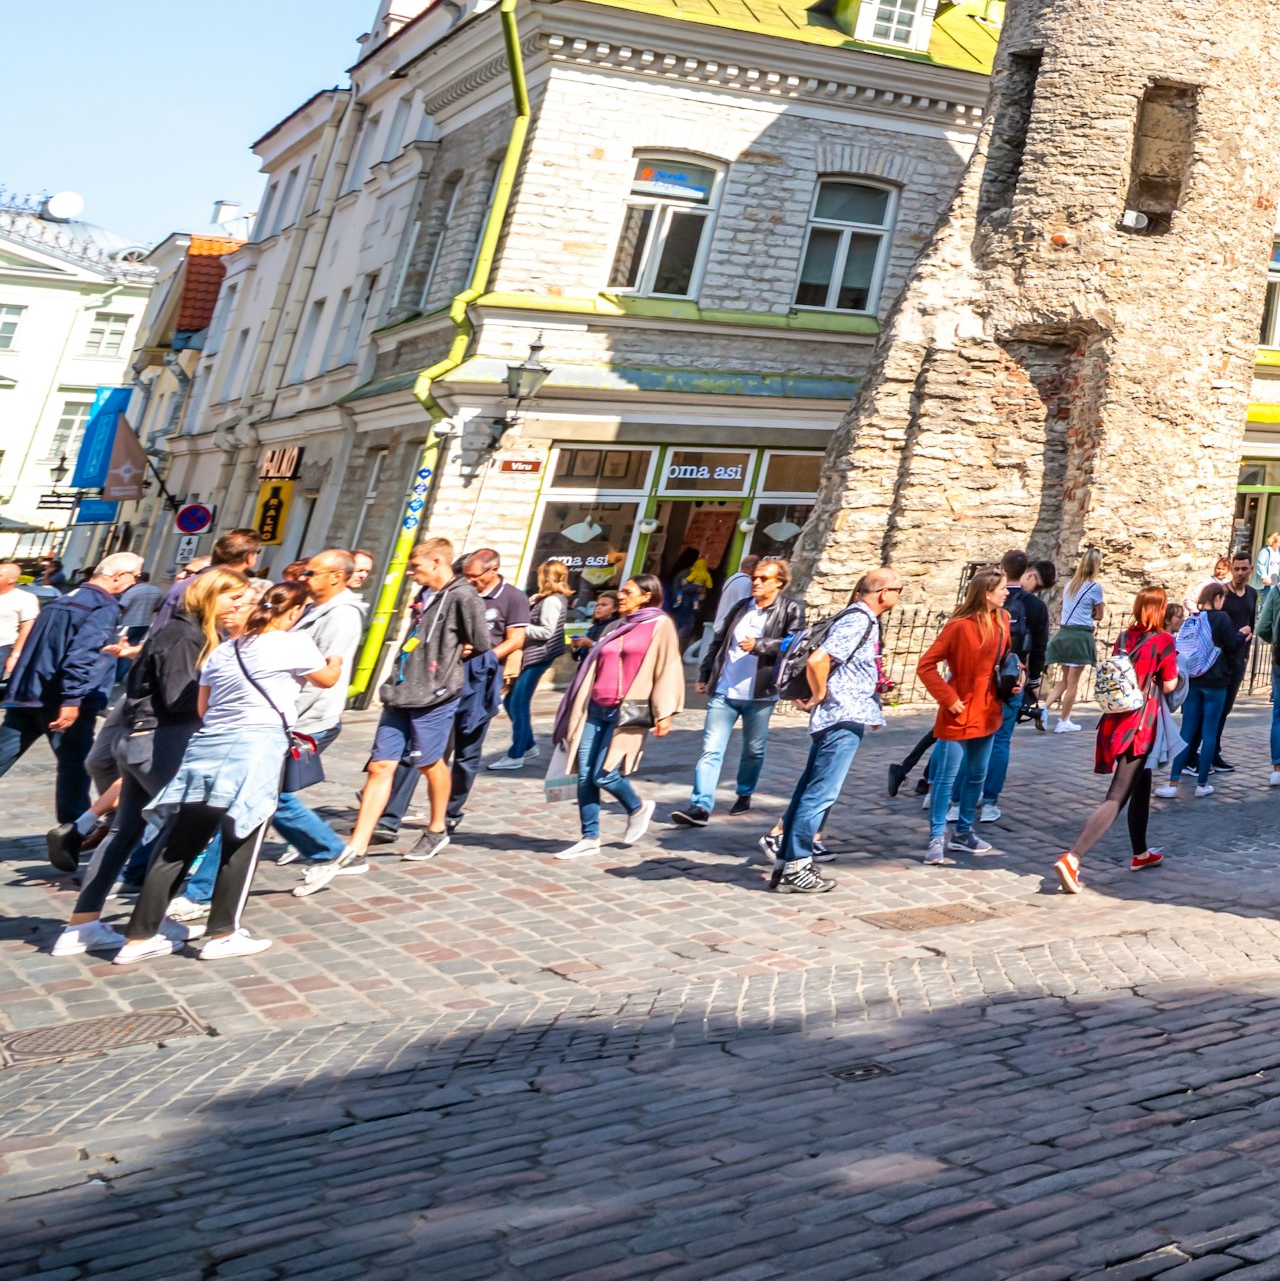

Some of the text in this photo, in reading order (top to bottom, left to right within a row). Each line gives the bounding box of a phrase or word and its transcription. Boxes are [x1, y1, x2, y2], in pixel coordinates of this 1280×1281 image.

[511, 462, 532, 471] Viru
[668, 464, 743, 479] oma asi
[179, 548, 193, 556] 20
[585, 555, 609, 566] asi
